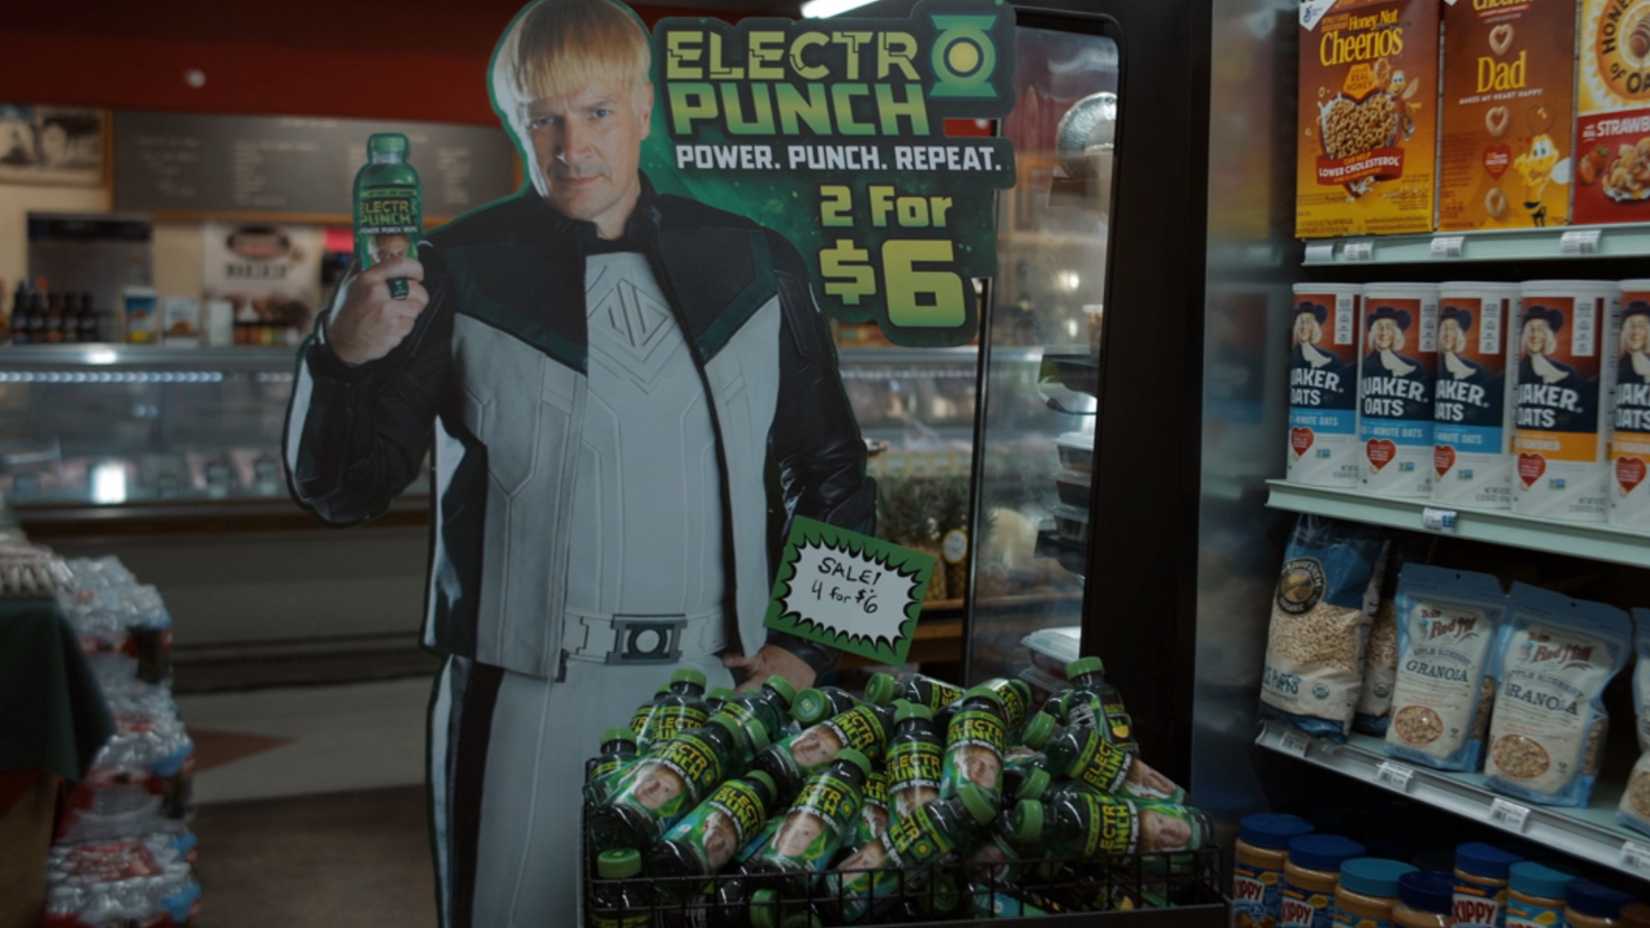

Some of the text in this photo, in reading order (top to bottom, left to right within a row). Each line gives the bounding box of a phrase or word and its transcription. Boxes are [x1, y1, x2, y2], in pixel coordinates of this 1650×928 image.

[1320, 28, 1403, 66] Cheerios
[1476, 49, 1527, 93] Dad
[667, 81, 931, 135] PUNCH
[675, 144, 1002, 171] POWER. PUNCH. REPEAT.
[820, 185, 953, 227] 2 For
[819, 239, 966, 327] $6
[1364, 398, 1404, 417] OATS
[818, 557, 882, 585] SALE!
[811, 580, 823, 601] 4
[829, 586, 852, 604] for
[1406, 660, 1469, 682] GRANOLA
[1455, 900, 1496, 924] KIPPY
